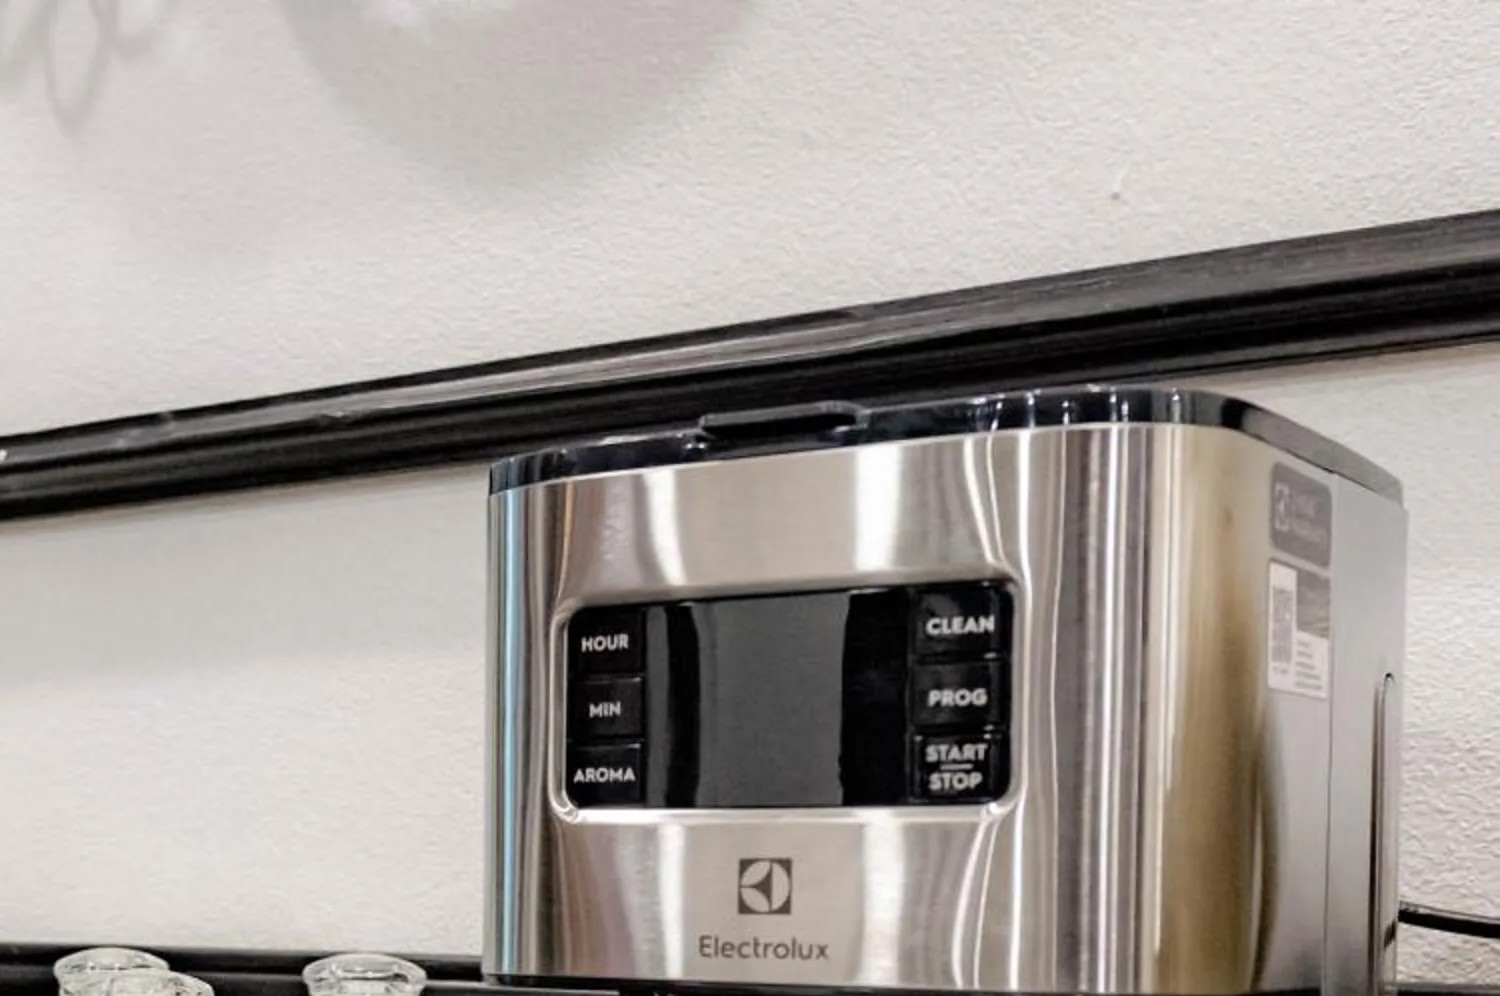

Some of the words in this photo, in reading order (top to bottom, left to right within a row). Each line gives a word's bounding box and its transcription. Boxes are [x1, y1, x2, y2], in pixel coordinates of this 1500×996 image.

[925, 614, 996, 635] CLEAN
[581, 633, 629, 652] HOUR
[928, 688, 988, 707] PROG
[589, 700, 622, 718] MIN
[925, 743, 988, 762] START
[573, 767, 636, 783] AROMA
[929, 771, 983, 791] STOP
[699, 935, 829, 961] Electrolux
